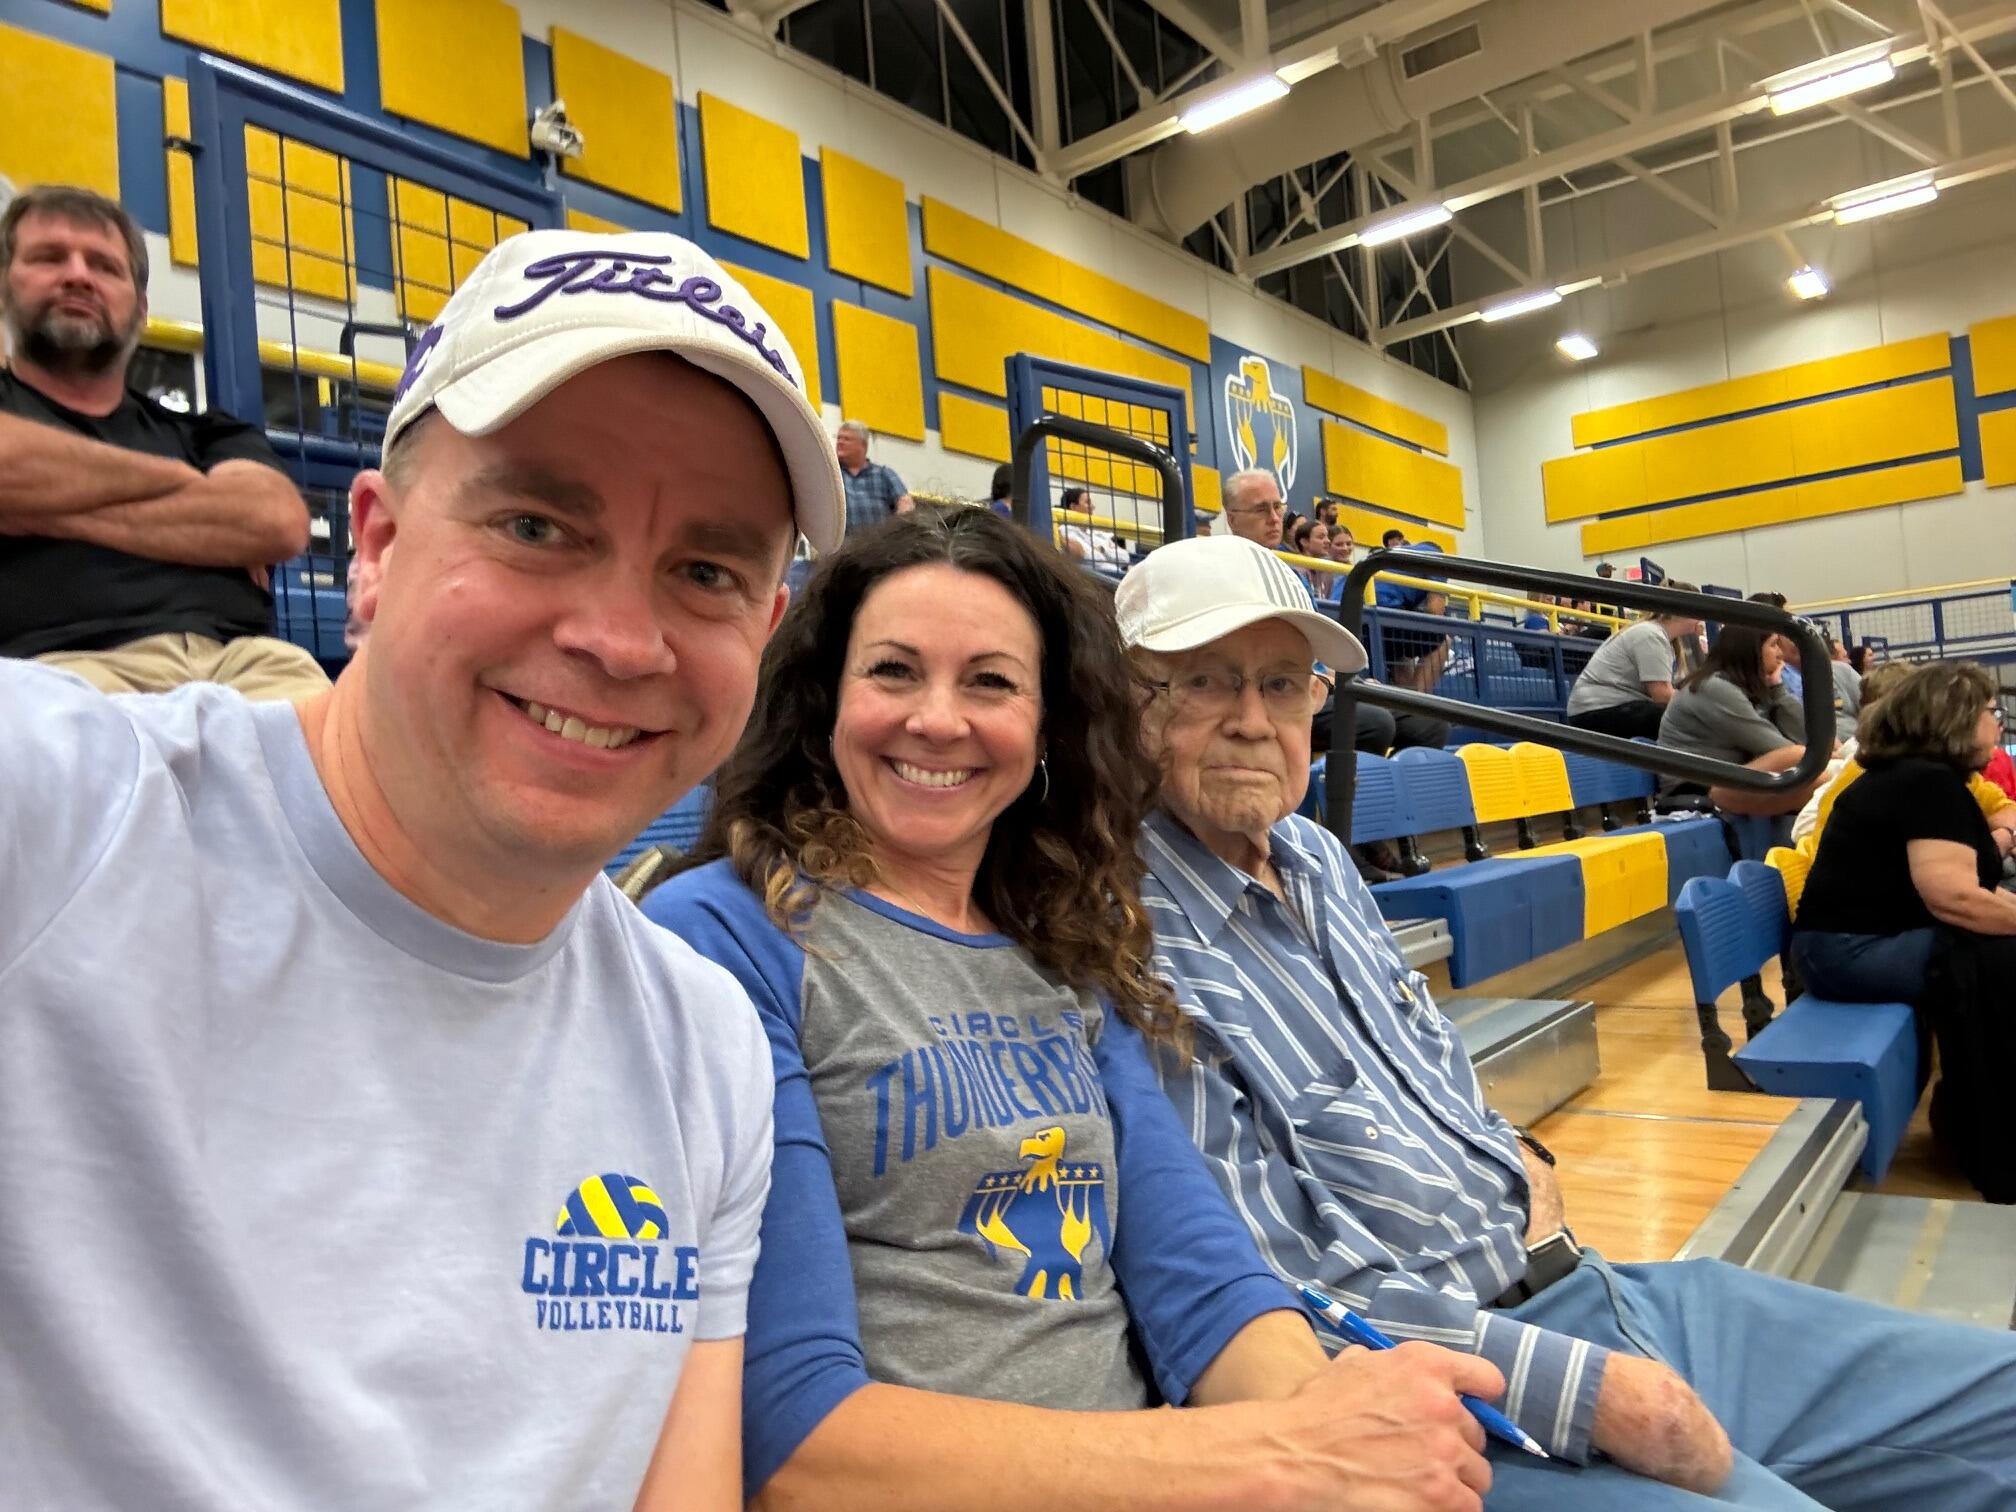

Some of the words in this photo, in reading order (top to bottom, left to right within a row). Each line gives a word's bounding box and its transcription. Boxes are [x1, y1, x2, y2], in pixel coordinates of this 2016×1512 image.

[494, 250, 798, 388] Titleis
[521, 1237, 699, 1300] CIRCLE
[537, 1300, 683, 1333] VOLLEYBALL
